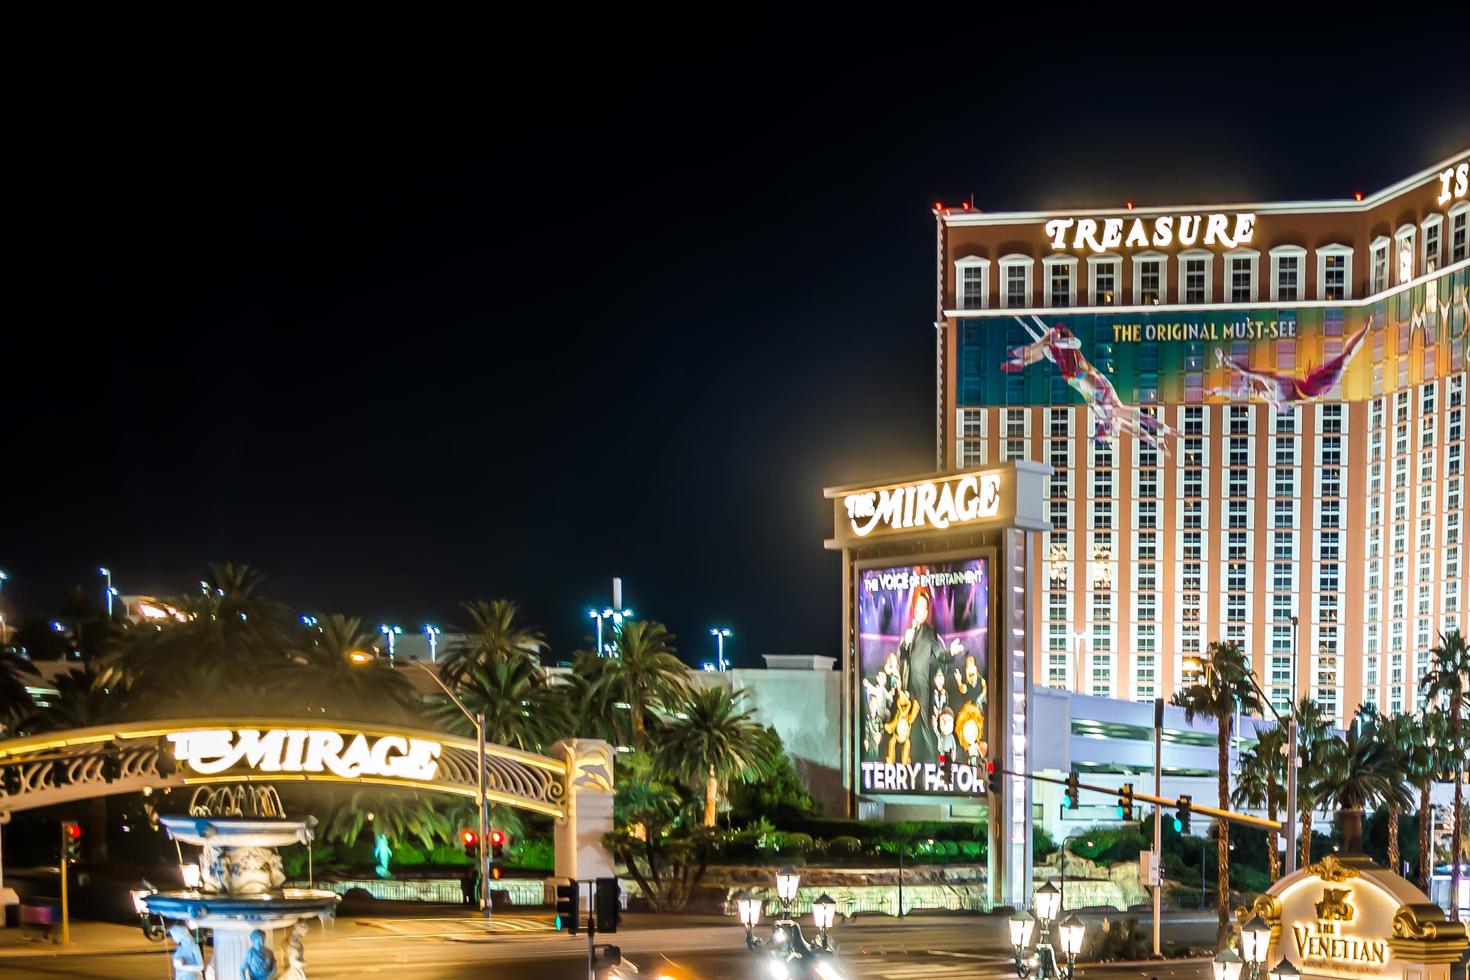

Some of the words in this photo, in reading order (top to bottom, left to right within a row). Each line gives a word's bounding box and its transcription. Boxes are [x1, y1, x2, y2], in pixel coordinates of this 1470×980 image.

[1045, 213, 1256, 253] TREASURE
[1113, 324, 1141, 342] THE
[1146, 322, 1219, 342] ORIGINAL
[1223, 320, 1296, 340] MUST-SEE
[851, 474, 1000, 537] MIRAGE
[879, 572, 909, 591] VOICE
[921, 570, 983, 588] ENTERTAINMENT
[188, 729, 441, 781] MIRAGE
[860, 761, 922, 791] TERRY
[1292, 926, 1385, 963] VENETIAN
[1317, 922, 1335, 934] THE
